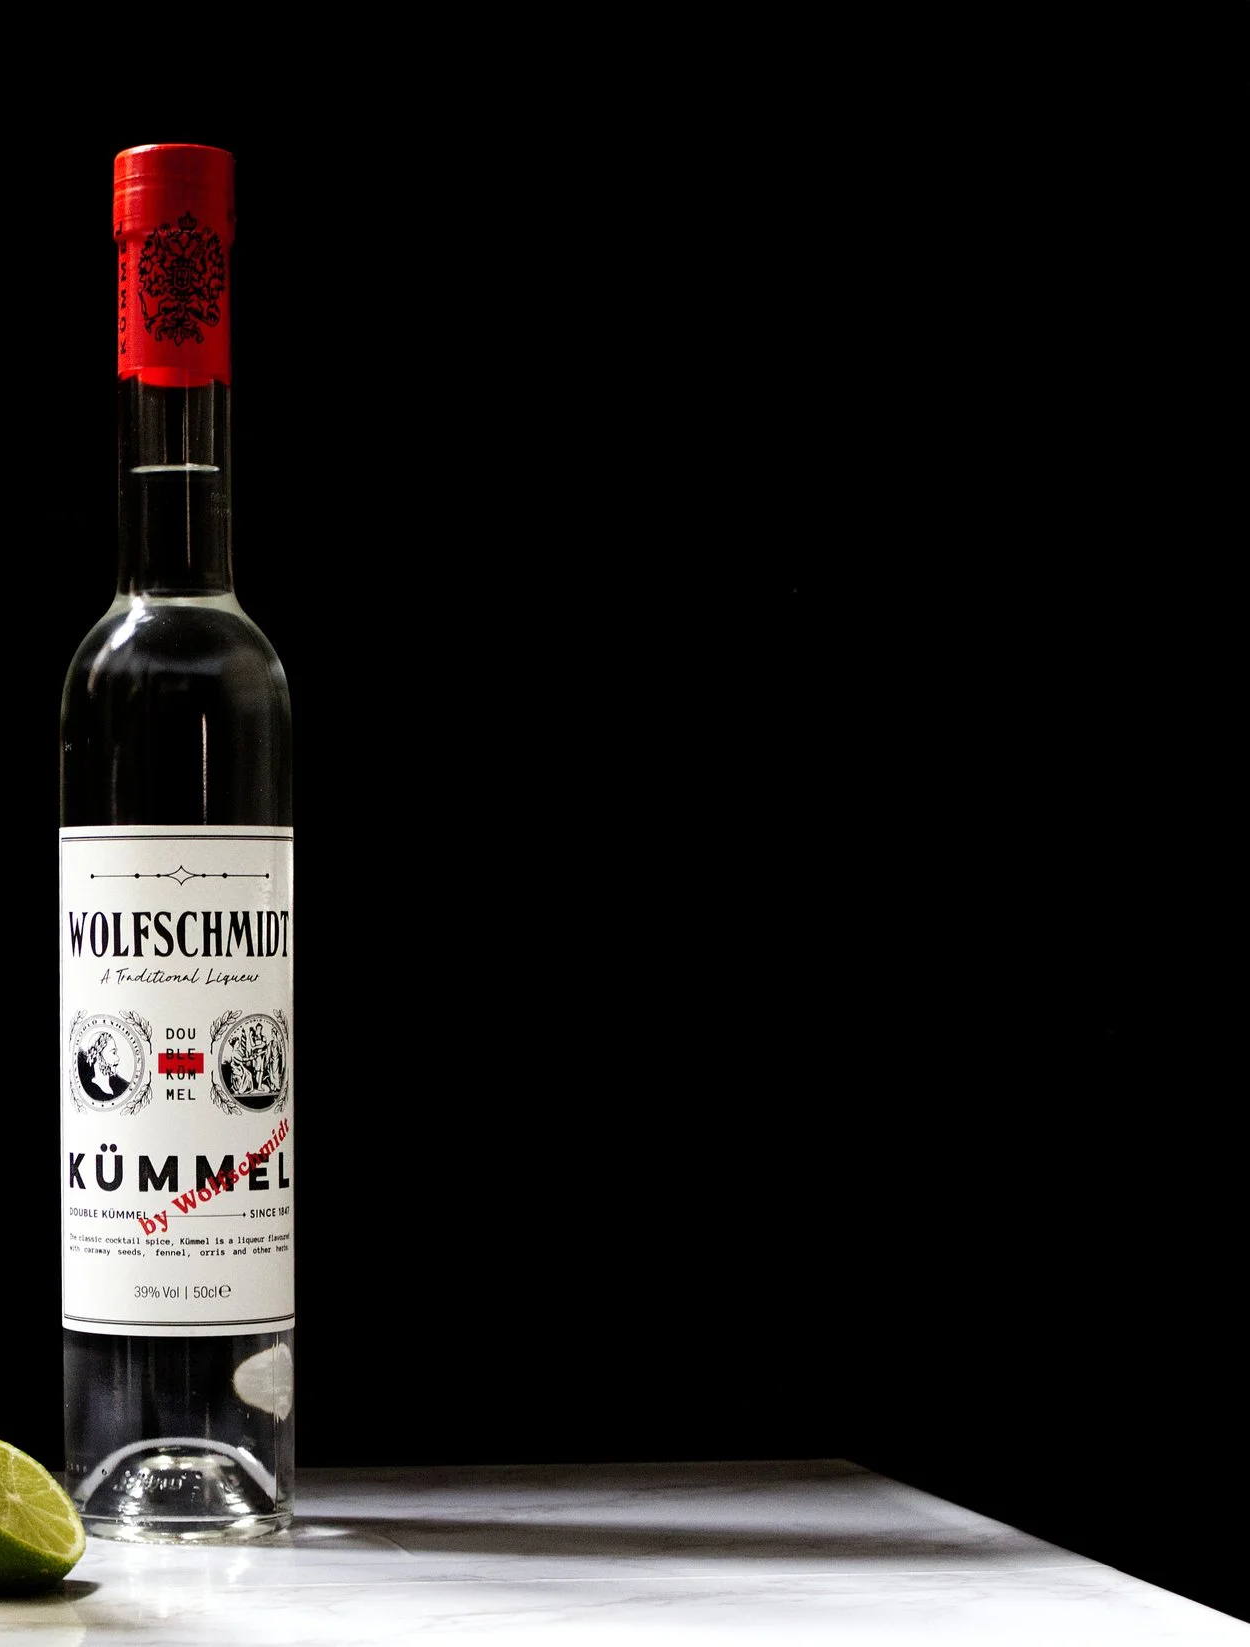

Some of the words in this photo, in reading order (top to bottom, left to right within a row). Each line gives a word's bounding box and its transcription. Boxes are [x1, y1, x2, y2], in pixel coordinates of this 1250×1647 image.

[68, 910, 289, 958] WOLFSCHMIDT
[100, 968, 110, 985] A
[116, 968, 200, 985] Traditional
[205, 968, 260, 985] Liqueur
[166, 1028, 196, 1040] DOU
[166, 1048, 196, 1060] BLE
[166, 1065, 196, 1080] KÜM
[166, 1089, 196, 1101] MEL
[69, 1143, 290, 1193] KÜMMEL
[138, 1210, 168, 1236] by
[171, 1117, 290, 1215] Wolfschmidt
[69, 1207, 98, 1218] DOUBLE
[101, 1208, 149, 1220] KÜMMEL
[250, 1208, 276, 1219] SINCE
[79, 1235, 102, 1243] classic
[105, 1237, 140, 1245] cocktail
[145, 1238, 174, 1247] spice,
[180, 1237, 210, 1245] Kümmel
[215, 1237, 225, 1245] is
[238, 1236, 265, 1245] liqueur
[84, 1246, 111, 1256] caraway
[117, 1248, 146, 1257] seeds,
[155, 1248, 191, 1258] fennel,
[200, 1248, 226, 1256] orris
[233, 1247, 247, 1256] and
[253, 1246, 272, 1255] other
[134, 1285, 161, 1299] 39%
[162, 1285, 180, 1299] Vol
